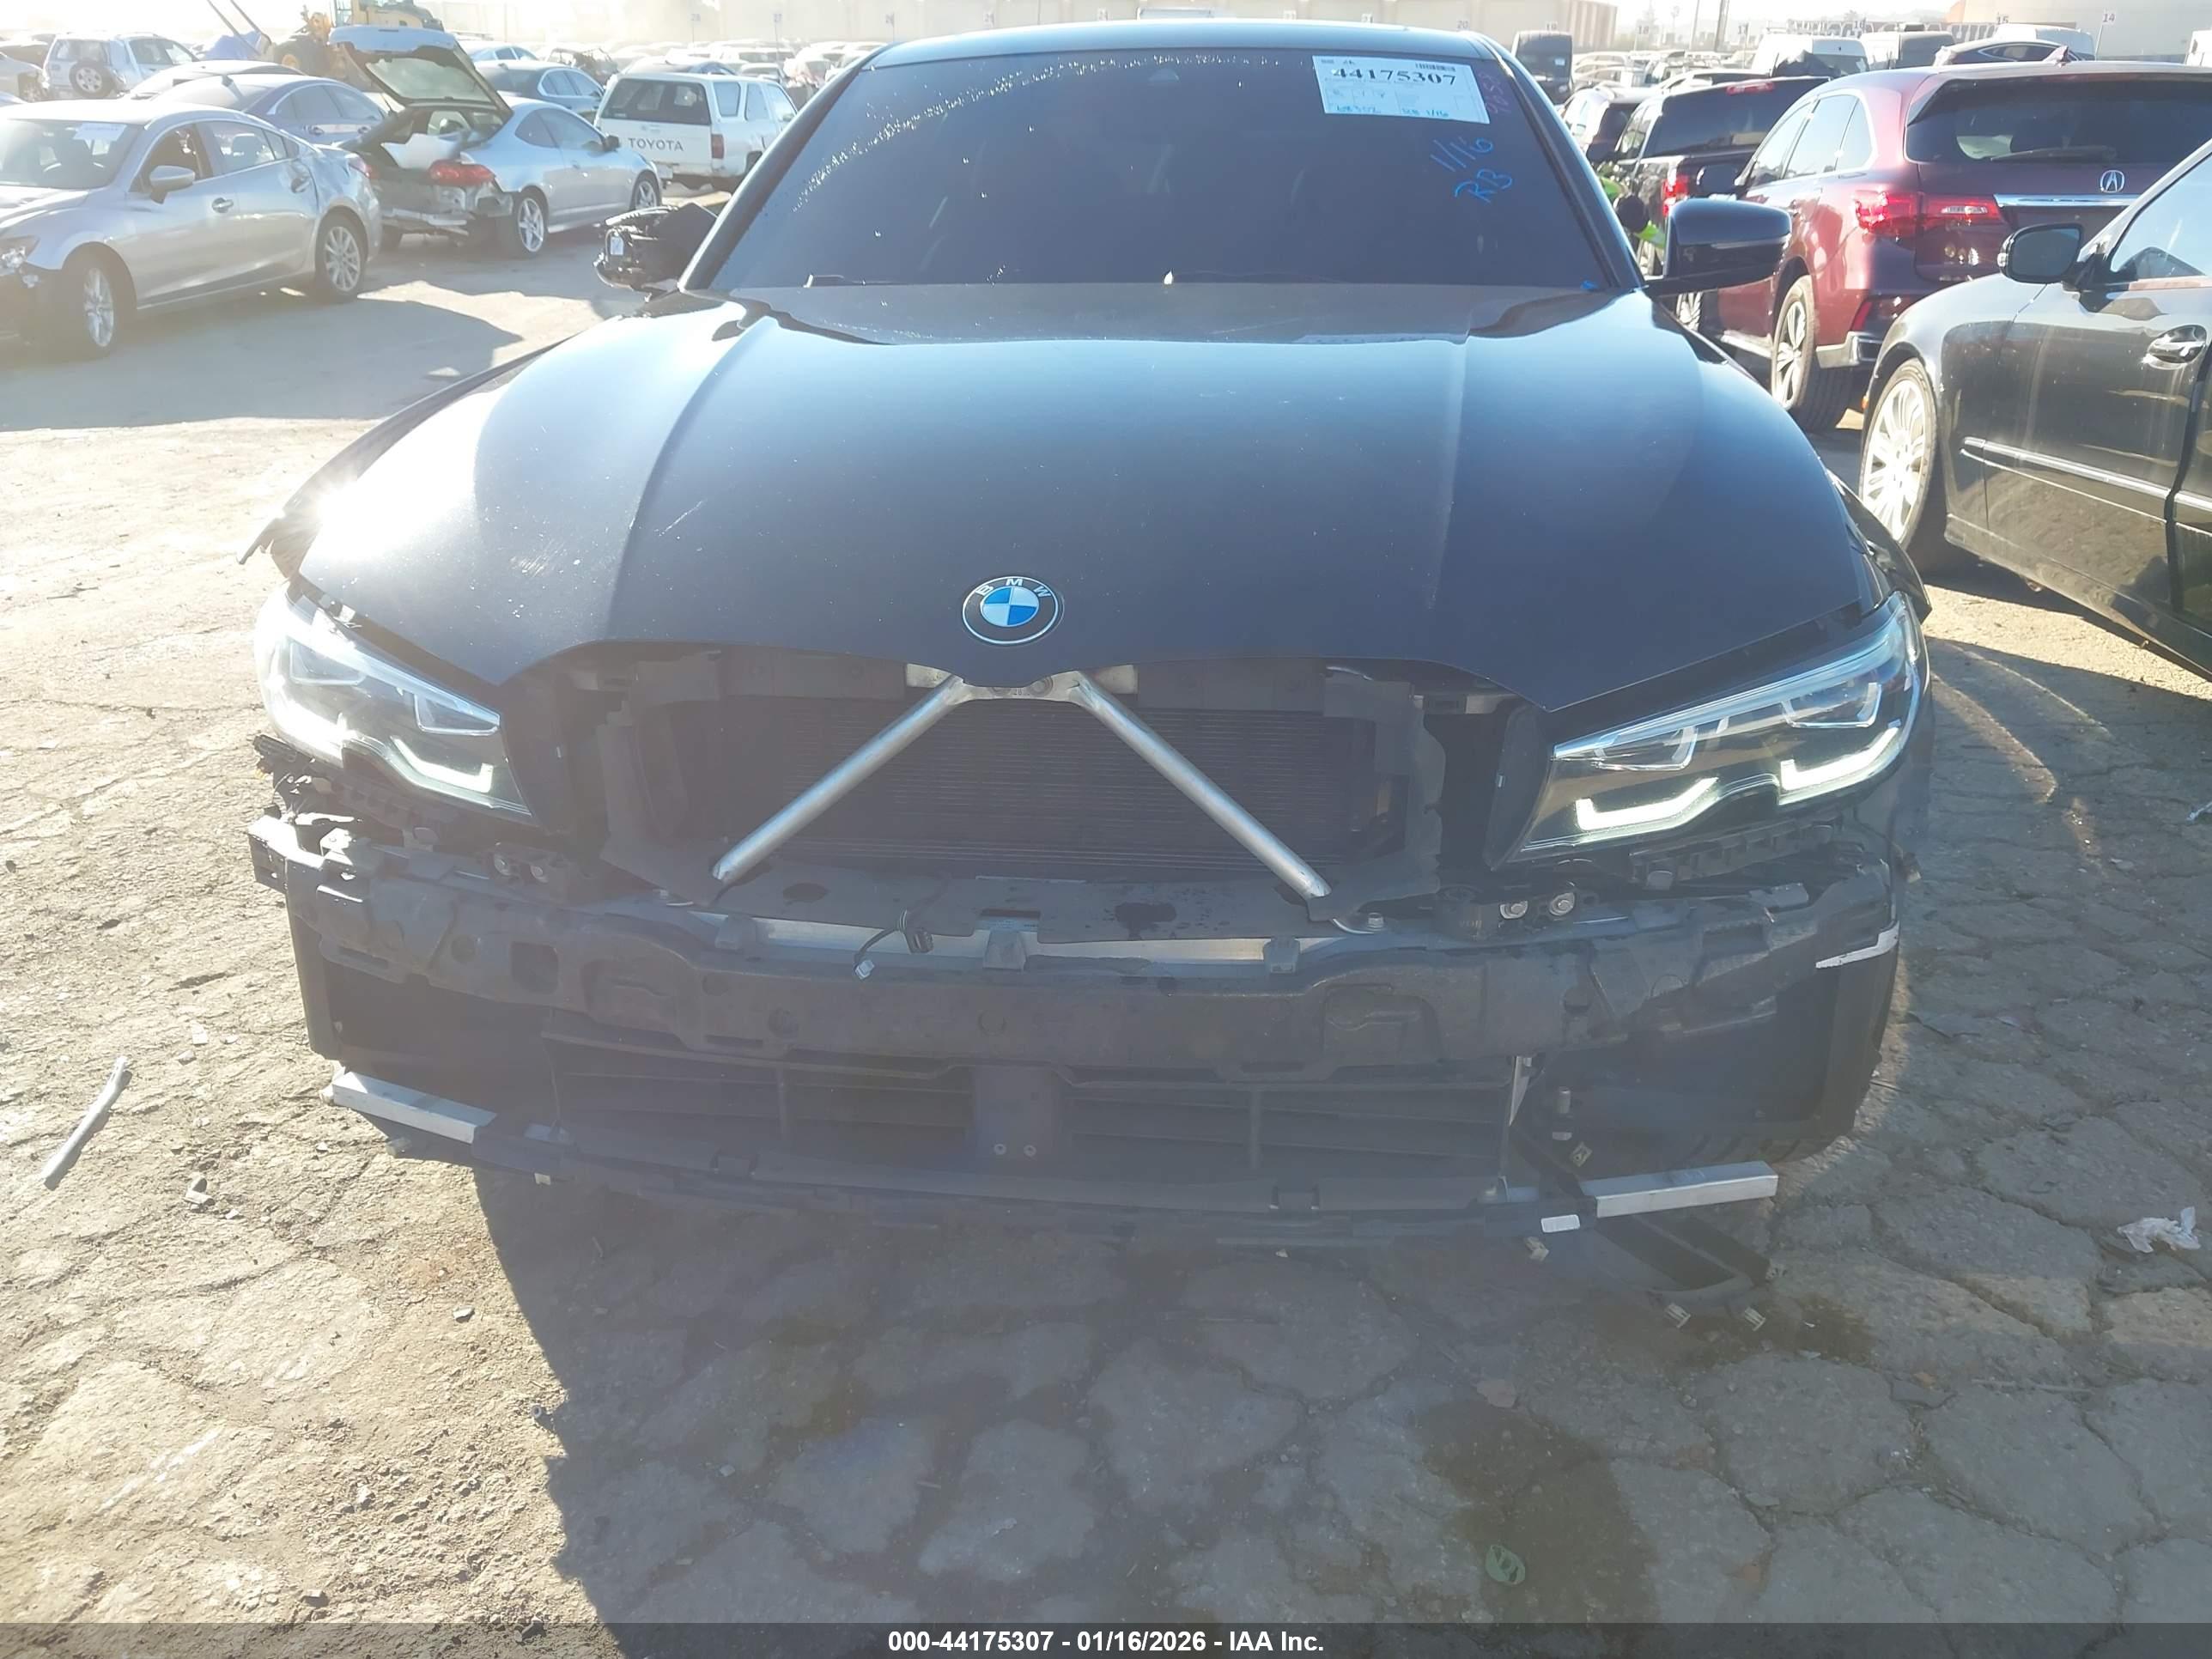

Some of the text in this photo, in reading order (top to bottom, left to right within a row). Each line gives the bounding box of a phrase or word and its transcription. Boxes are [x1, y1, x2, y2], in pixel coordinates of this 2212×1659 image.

[1996, 15, 2009, 25] 15
[2103, 13, 2116, 22] 14
[1333, 68, 1456, 86] 44175307
[628, 137, 684, 152] TOYOTA
[975, 578, 1052, 598] BMW
